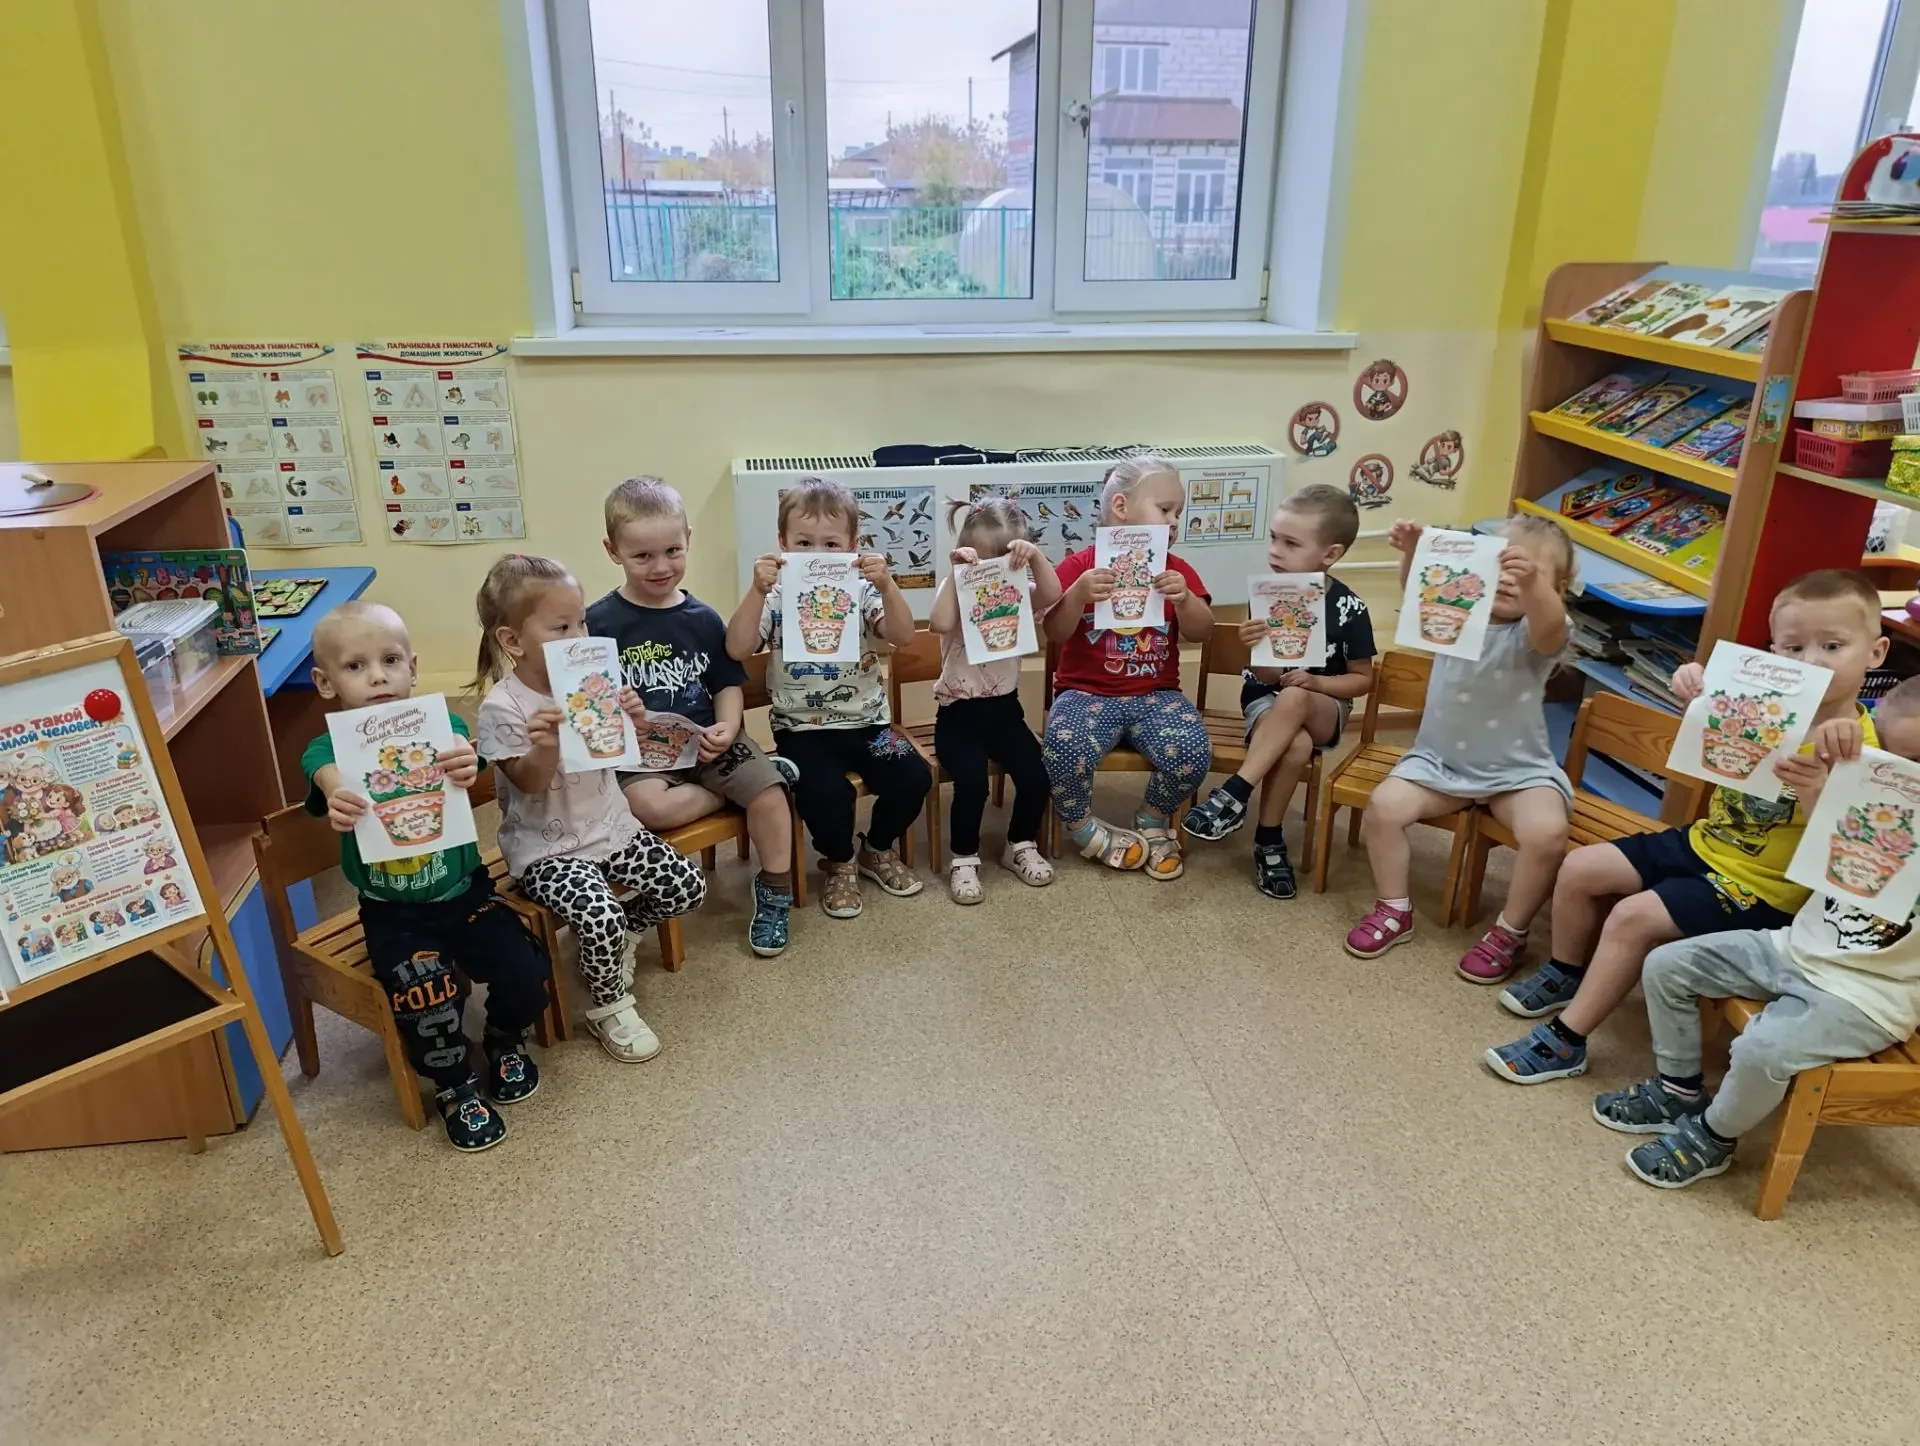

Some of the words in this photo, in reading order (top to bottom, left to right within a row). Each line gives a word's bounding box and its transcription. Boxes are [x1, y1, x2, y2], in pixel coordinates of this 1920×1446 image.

[267, 342, 320, 350] ГИМНАСТИКА
[443, 341, 494, 349] ГИМНАСТИКА
[400, 350, 441, 358] ДОМАШНИЕ
[873, 489, 907, 499] ПТИЦЫ
[1059, 484, 1094, 495] ПТИЦЫ
[30, 707, 83, 730] такой
[378, 708, 421, 730] праздником,
[360, 729, 392, 748] милая
[394, 712, 426, 734] бабушка!
[0, 731, 39, 752] илой
[1716, 748, 1747, 760] Любим
[1721, 757, 1740, 766] вас!
[400, 811, 430, 828] Любим
[408, 819, 426, 832] вас!
